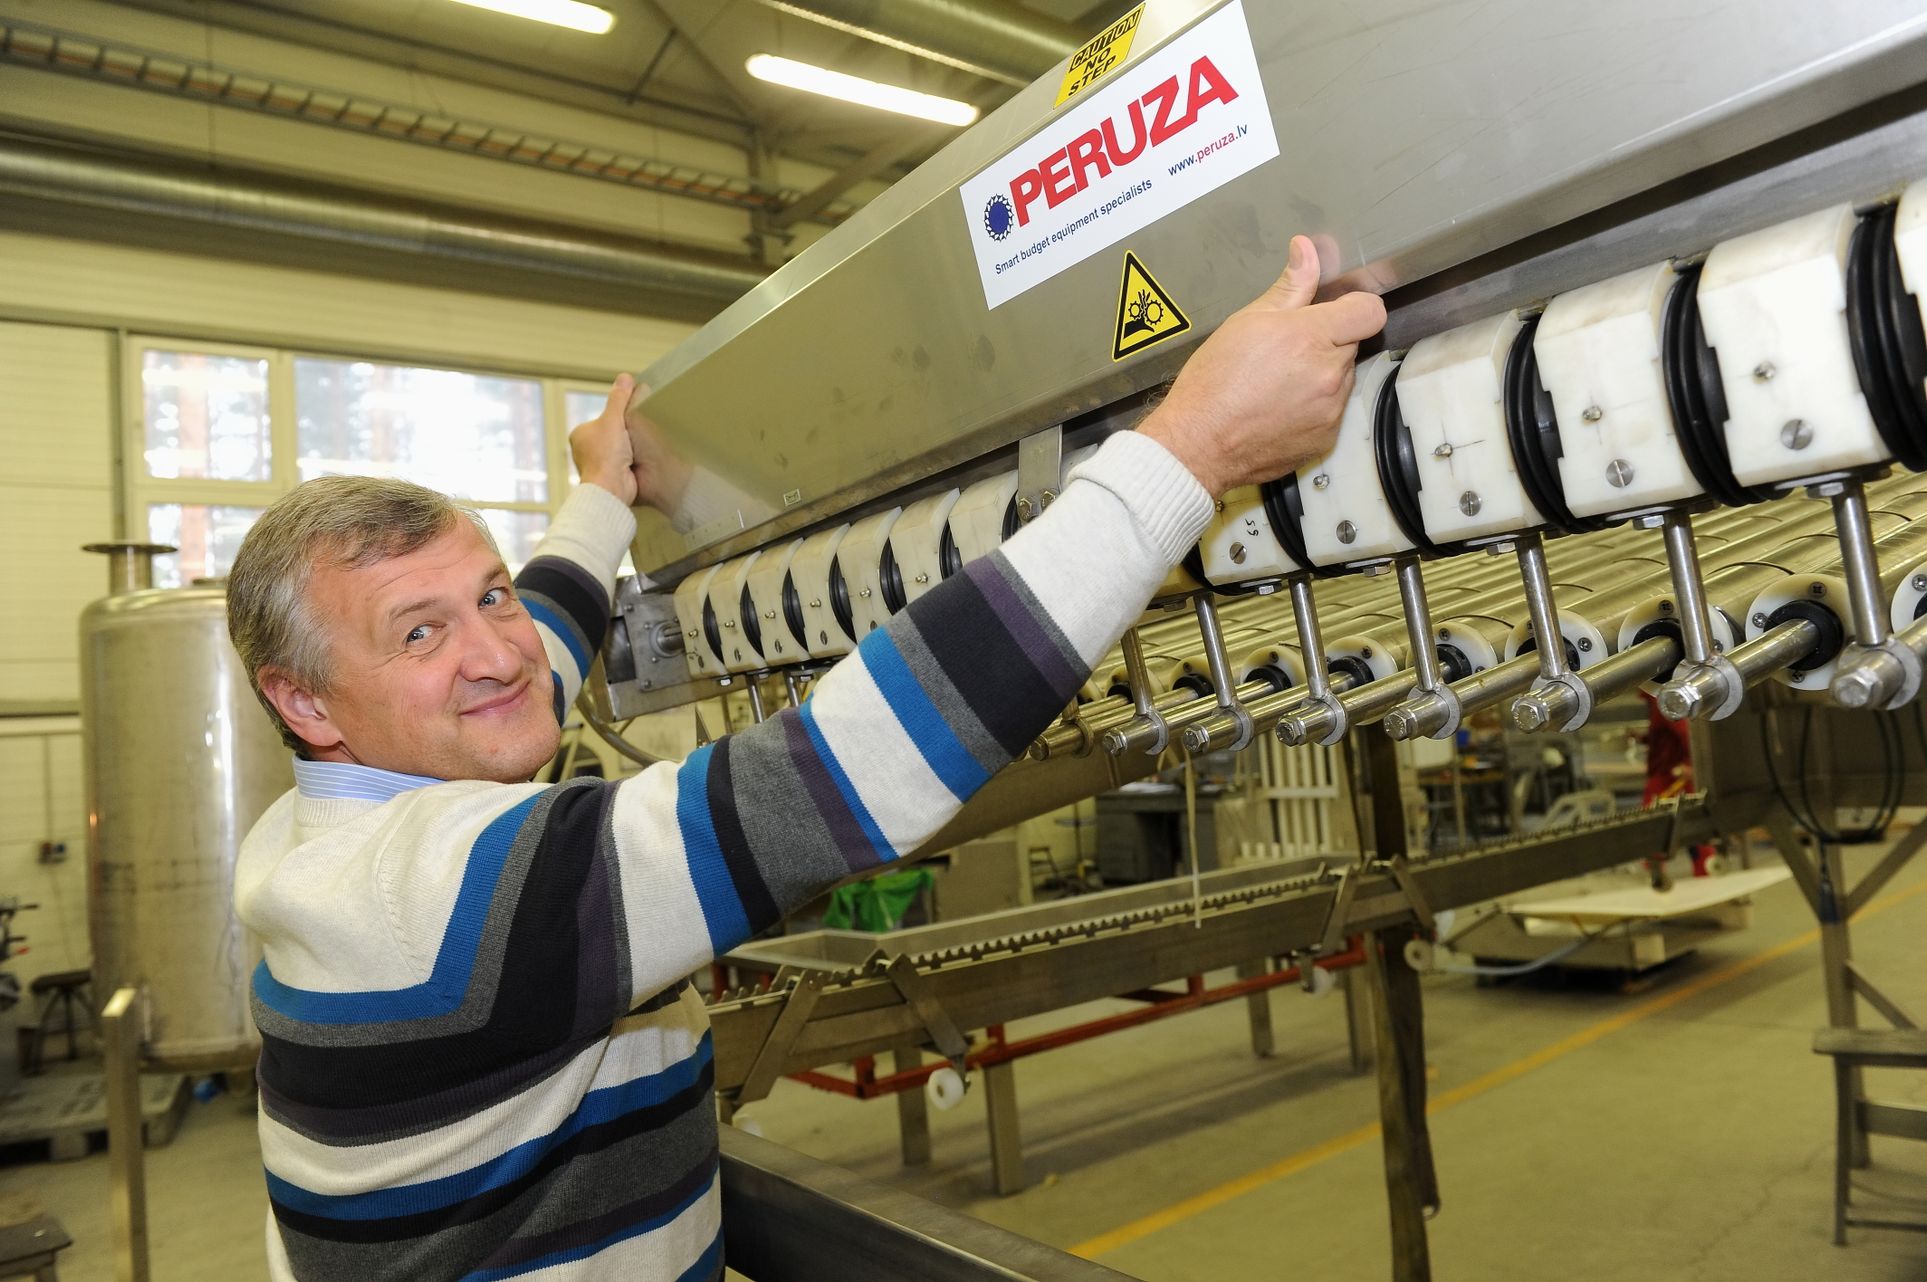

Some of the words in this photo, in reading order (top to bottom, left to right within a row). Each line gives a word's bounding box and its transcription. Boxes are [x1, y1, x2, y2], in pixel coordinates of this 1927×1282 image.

[1070, 10, 1139, 71] CAUTION
[1084, 47, 1111, 74] NO
[1068, 55, 1116, 96] STEP
[1009, 55, 1239, 227] PERUZA
[1168, 124, 1248, 176] www.peruza.lv
[995, 253, 1020, 275] Smart
[1020, 237, 1050, 260] budget
[1051, 209, 1099, 244] equipment
[1100, 179, 1153, 215] specialists
